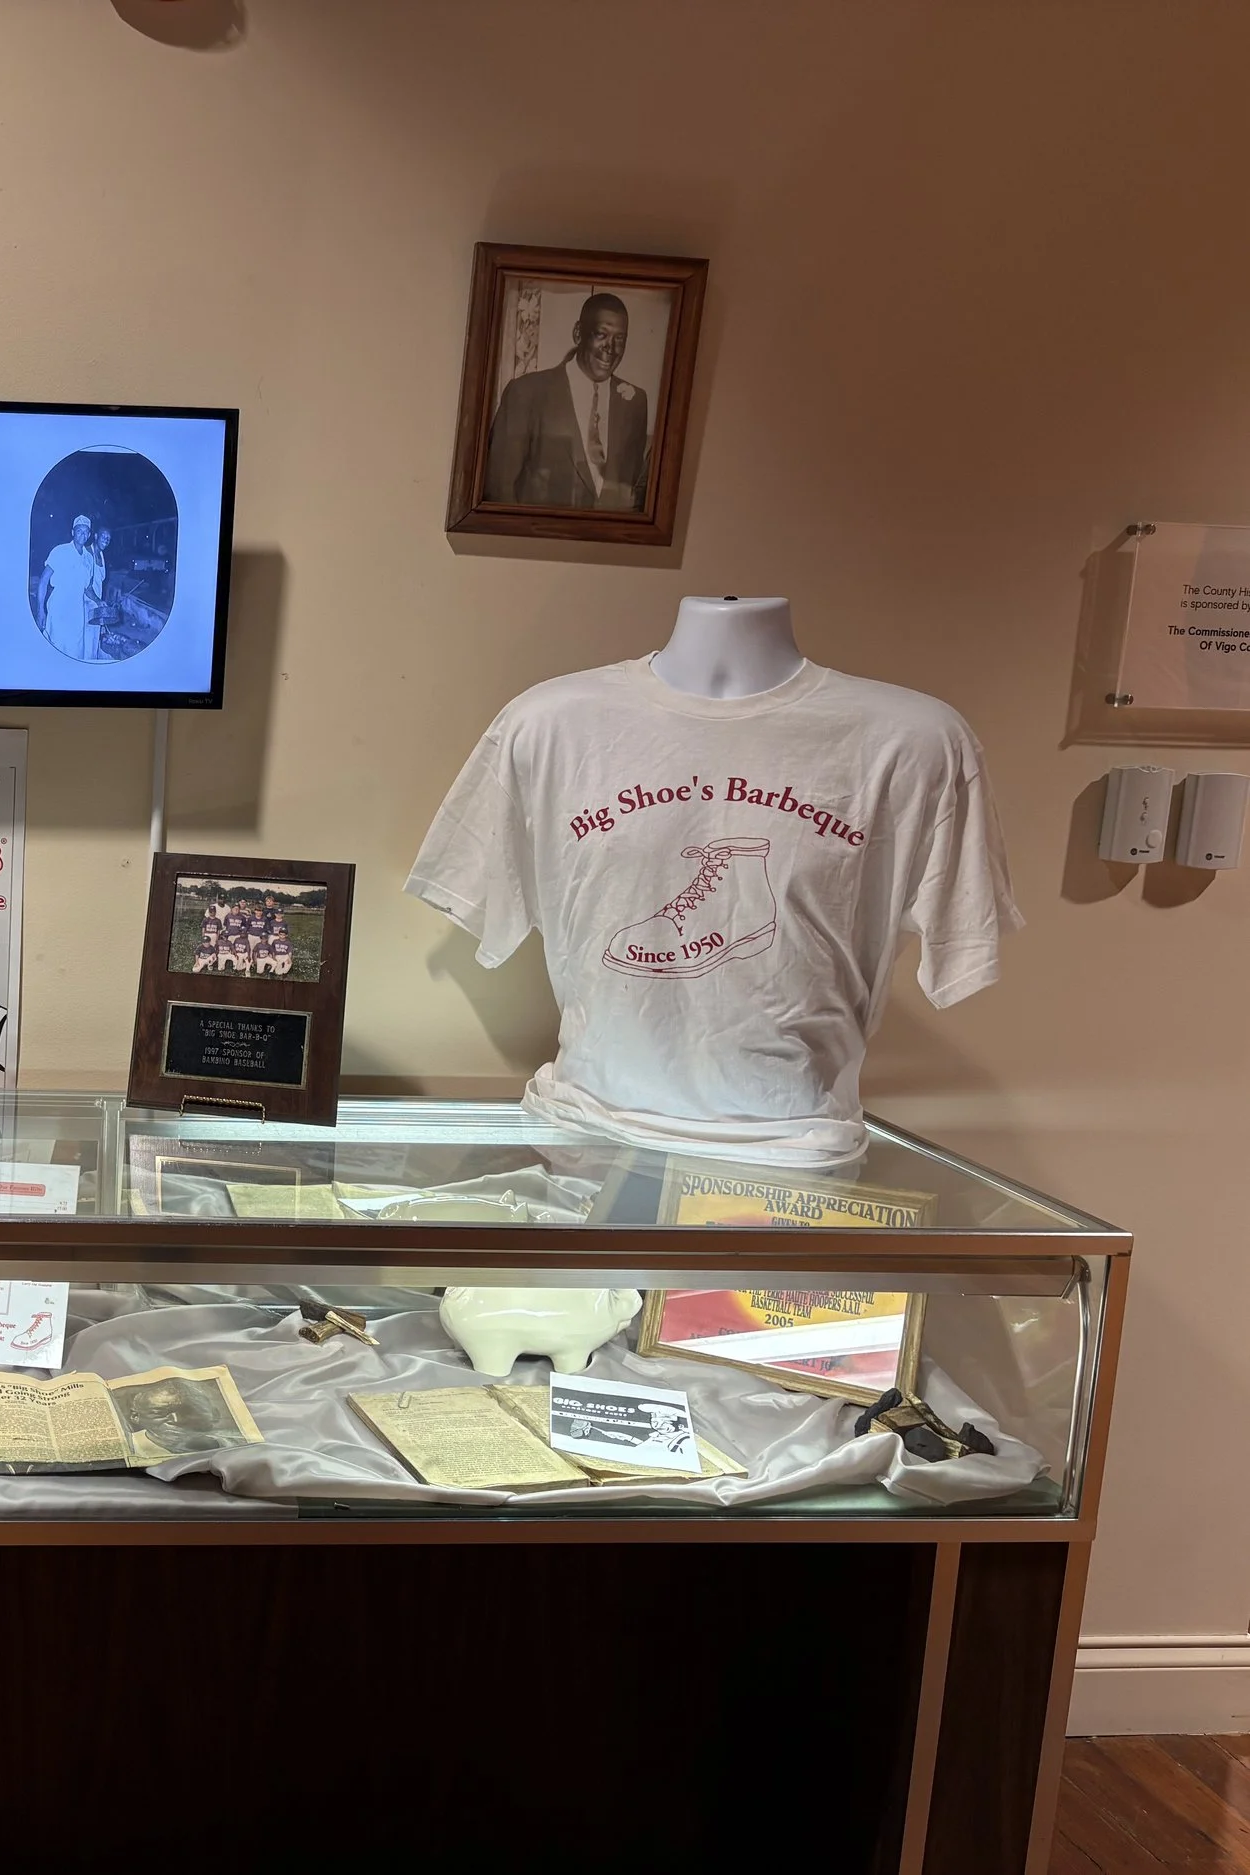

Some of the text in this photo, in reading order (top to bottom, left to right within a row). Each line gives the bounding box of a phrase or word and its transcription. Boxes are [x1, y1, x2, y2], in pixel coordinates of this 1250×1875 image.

[1183, 584, 1237, 599] The County
[1180, 599, 1188, 608] is
[1190, 600, 1240, 612] sponsored
[1168, 625, 1250, 638] The Commissione
[1199, 640, 1237, 654] Of Vigo
[569, 776, 866, 847] Big Shoe's Barbeque
[625, 931, 725, 964] Since 1950
[207, 1020, 234, 1031] SPECIAL
[237, 1022, 263, 1033] THANKS
[266, 1025, 276, 1034] TO
[219, 1030, 236, 1039] SHOE
[204, 1047, 266, 1060] 1997 SPONSOR OF
[202, 1055, 267, 1069] BAMBINO BASEBALL
[681, 1174, 919, 1227] SPONSORSHIP APPRECIATION
[764, 1198, 824, 1221] AWARD
[772, 1216, 798, 1227] GIVEN
[750, 1295, 812, 1319] BASKETBALL TEAM
[810, 1294, 842, 1312] HOOPERS
[764, 1314, 795, 1328] 2005
[61, 1383, 85, 1392] Mills
[5, 1389, 36, 1399] Going
[37, 1391, 71, 1401] Strong
[29, 1397, 57, 1406] Years
